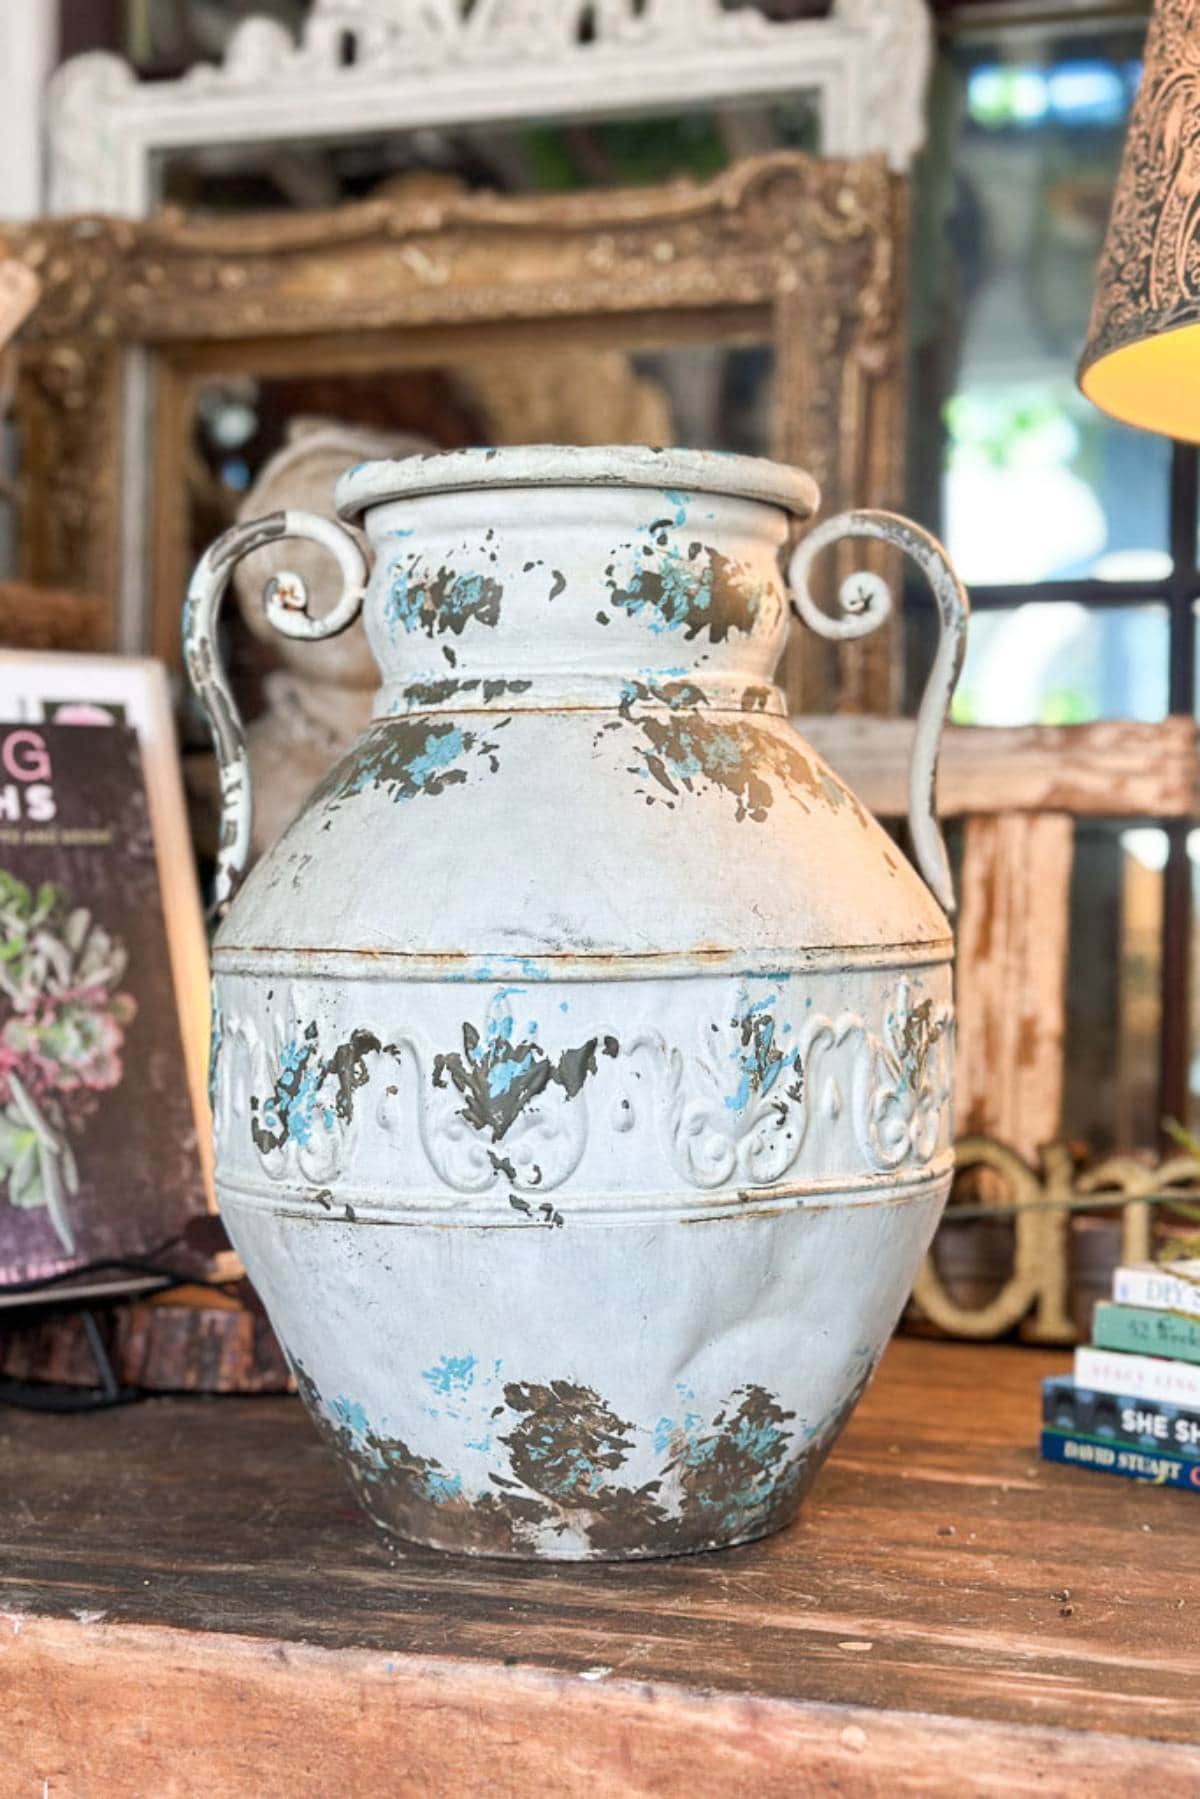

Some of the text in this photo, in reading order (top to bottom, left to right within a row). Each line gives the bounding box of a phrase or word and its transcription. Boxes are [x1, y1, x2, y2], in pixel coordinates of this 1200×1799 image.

[1121, 1408, 1169, 1439] SHE
[1063, 1440, 1115, 1467] DAVID
[1117, 1453, 1182, 1484] STUART
